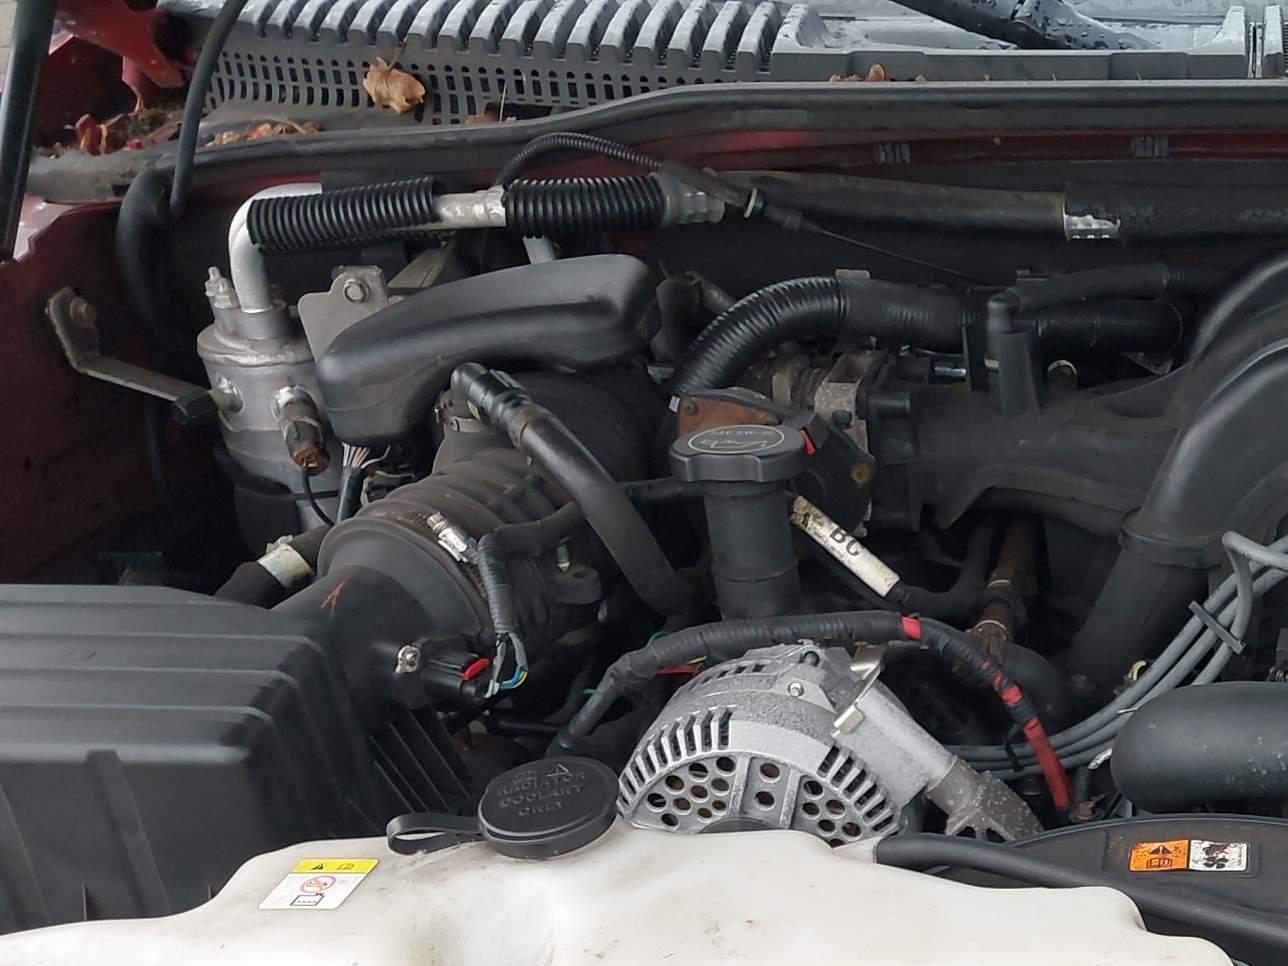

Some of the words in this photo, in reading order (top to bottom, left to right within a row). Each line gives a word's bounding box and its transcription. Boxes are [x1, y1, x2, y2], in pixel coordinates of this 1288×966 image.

[496, 770, 586, 797] RADIATOR
[498, 784, 585, 808] COOLANT
[517, 800, 563, 817] ONLY
